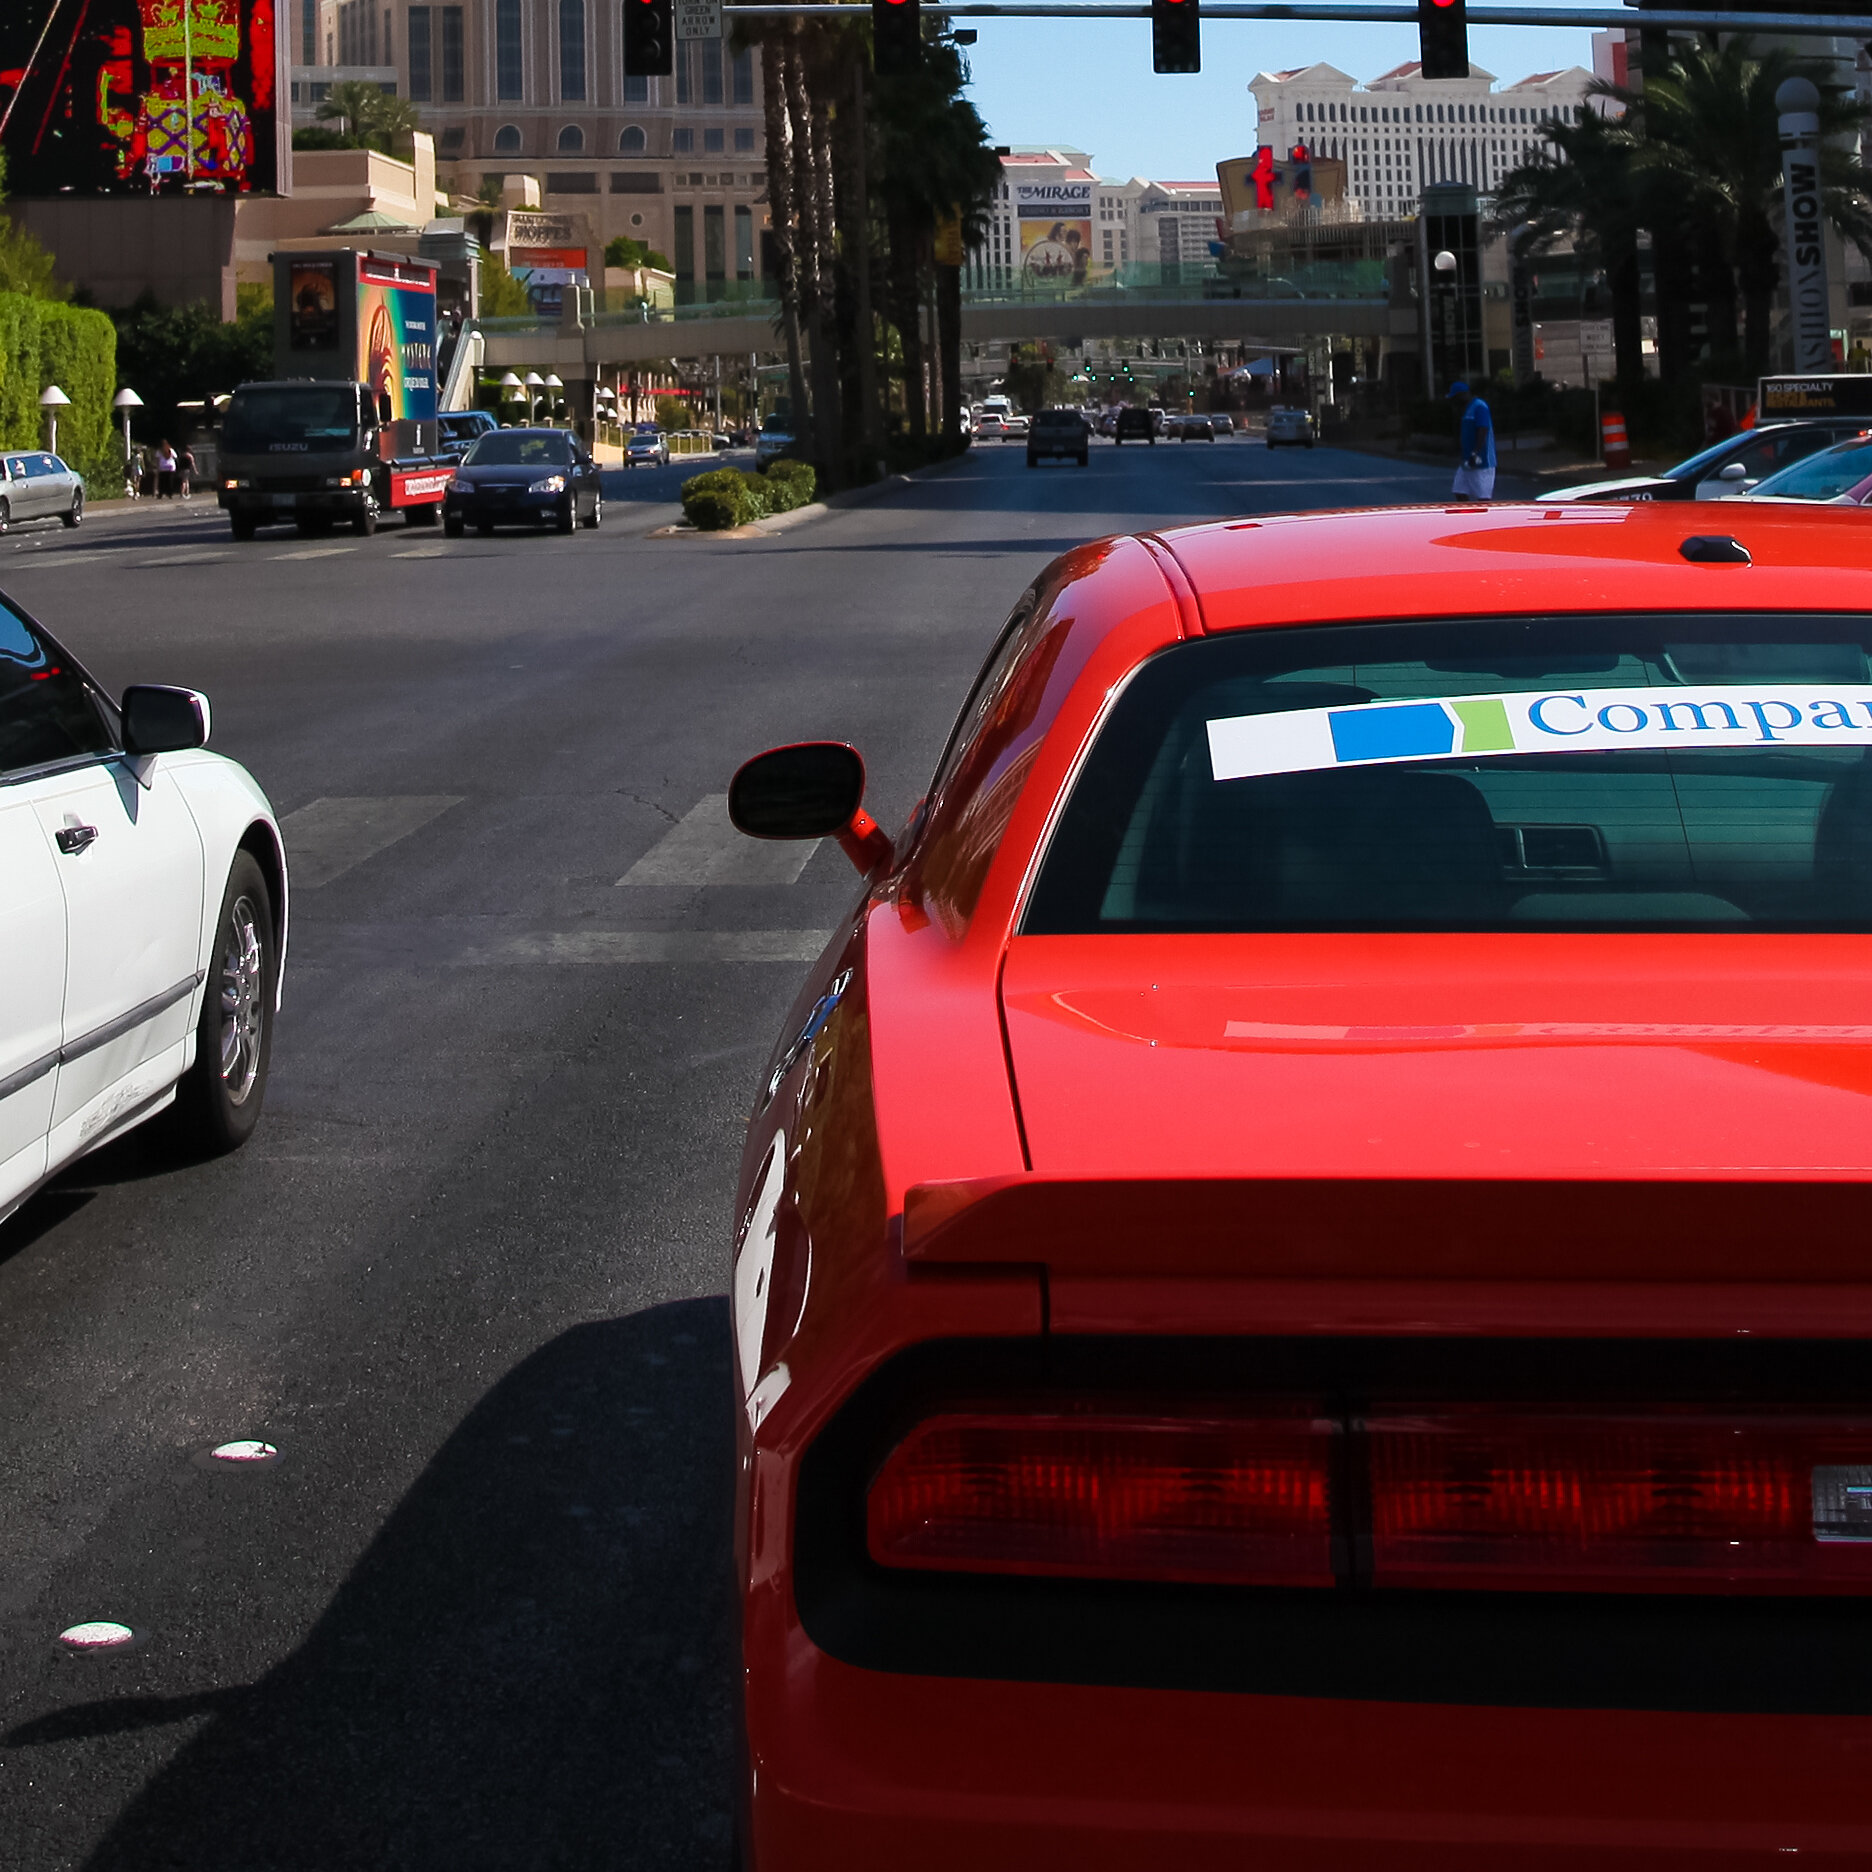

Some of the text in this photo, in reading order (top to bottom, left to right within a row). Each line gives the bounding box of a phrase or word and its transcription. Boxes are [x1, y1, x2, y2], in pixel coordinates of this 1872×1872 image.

[682, 16, 715, 26] ARROW
[686, 26, 710, 36] ONLY
[1017, 186, 1091, 201] THE MIRAGE
[1790, 163, 1821, 266] SHOW
[1784, 382, 1834, 393] SPECIALTY
[269, 442, 309, 451] ISUZU
